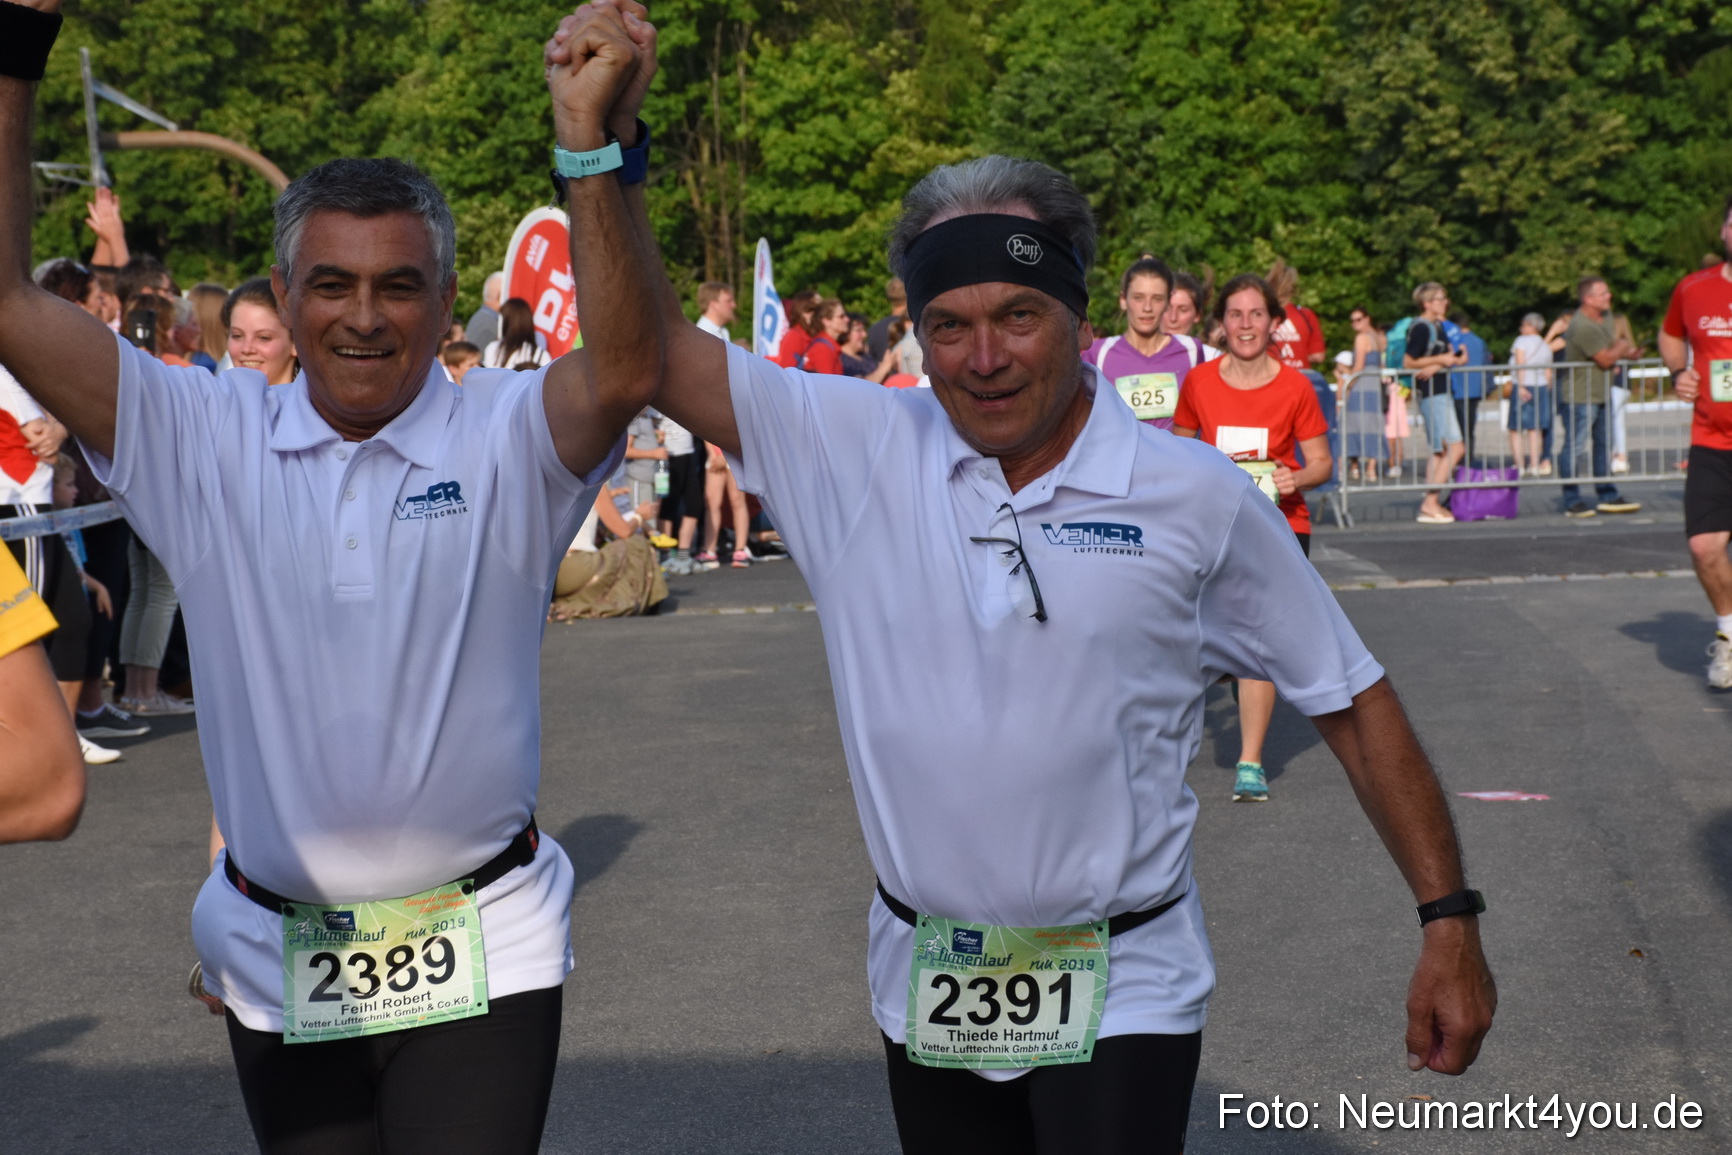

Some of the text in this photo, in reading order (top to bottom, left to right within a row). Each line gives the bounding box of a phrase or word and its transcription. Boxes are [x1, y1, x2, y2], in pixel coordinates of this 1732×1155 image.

[1131, 389, 1165, 407] 625
[1040, 522, 1144, 548] VETTER
[1073, 547, 1144, 557] LUFTTECHNIK
[314, 926, 388, 942] firmenlauf
[404, 916, 466, 941] run 2019
[939, 947, 1014, 967] firmenlauf
[1029, 958, 1095, 971] run 2019
[308, 935, 456, 1002] 2389
[341, 991, 432, 1015] Feihl Robert
[928, 973, 1072, 1026] 2391
[300, 1018, 332, 1029] Vetter
[335, 1011, 391, 1027] Lufttechnik
[394, 1005, 424, 1018] Gmbh
[427, 1003, 434, 1011] &
[437, 995, 470, 1010] Co.KG
[947, 1028, 1060, 1042] Thiede Hartmut
[921, 1040, 1079, 1054] Vetter Lufttechnik Gmbh & Co.KG
